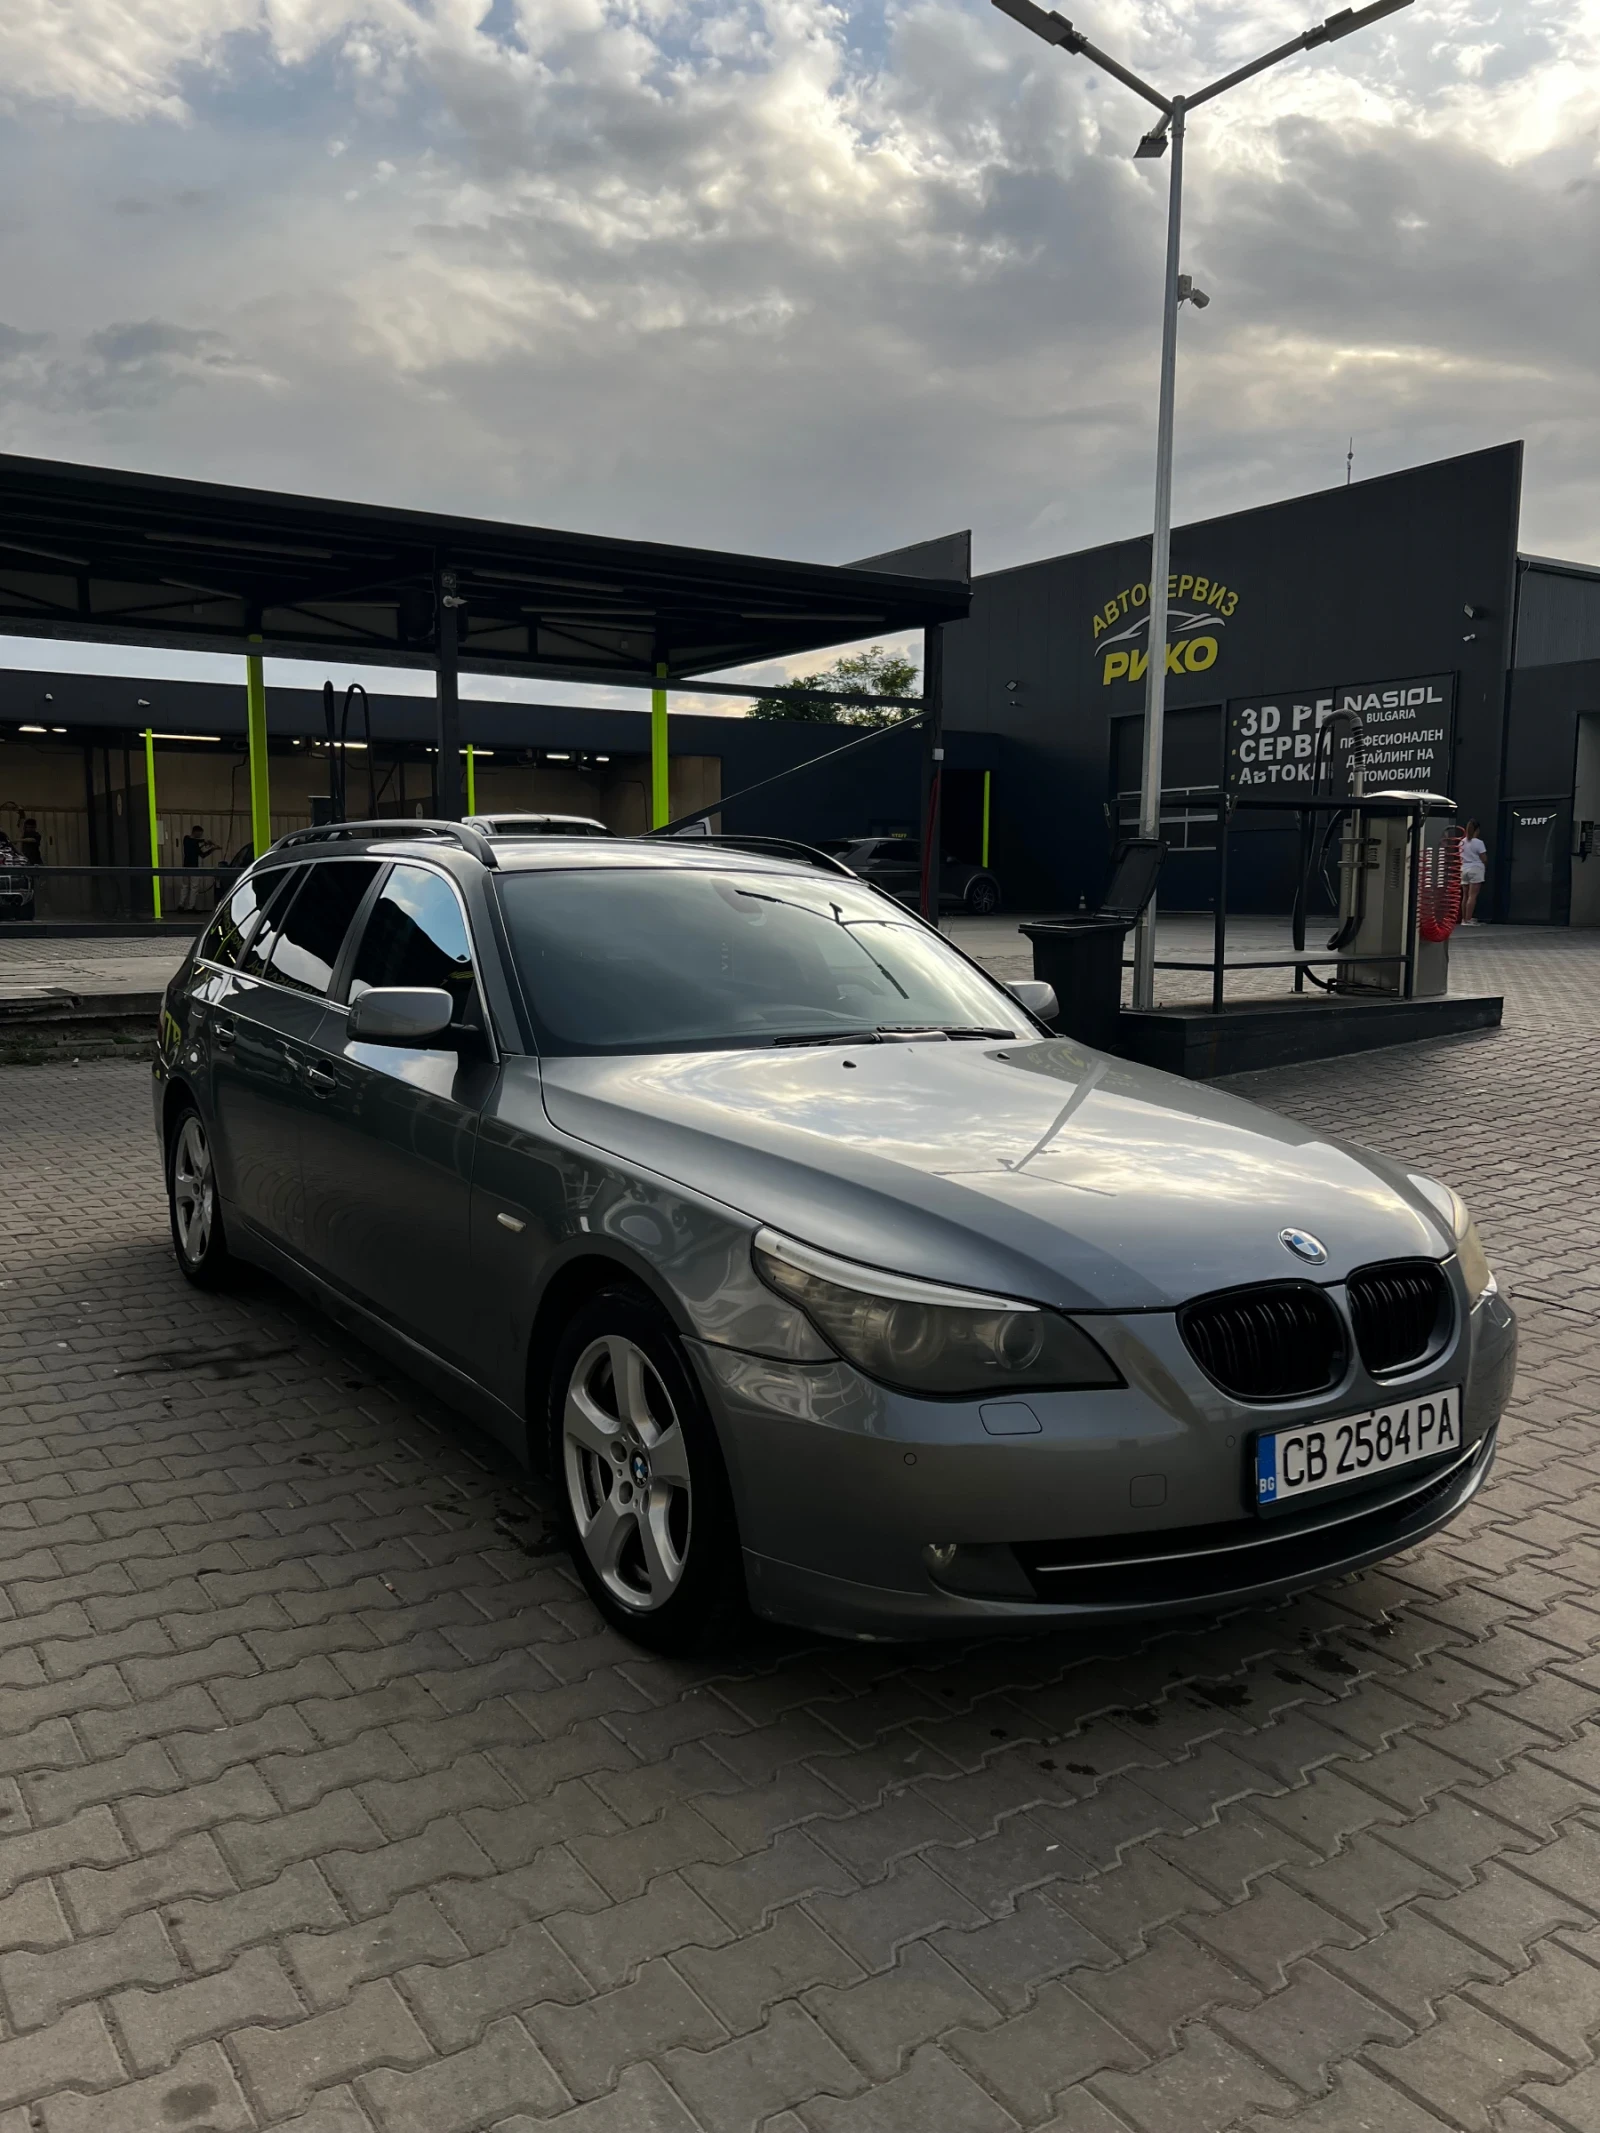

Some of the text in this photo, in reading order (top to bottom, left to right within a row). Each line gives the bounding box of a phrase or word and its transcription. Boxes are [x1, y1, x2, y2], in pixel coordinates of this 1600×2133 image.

[1093, 574, 1239, 639] АВТОЕРВИЗ
[1343, 686, 1443, 712] NASIOL
[1240, 706, 1281, 737] 3D
[1366, 708, 1416, 723] BULGARIA
[1339, 728, 1444, 749] ПРФЕСИОНАЛЕН
[1345, 747, 1435, 769] ДТАЙЛИНГ НА
[1347, 766, 1432, 783] АТОМОБИЛИ
[1520, 817, 1548, 825] STAFF
[1282, 1397, 1455, 1488] CB 2584 PA
[1259, 1476, 1276, 1494] BG
